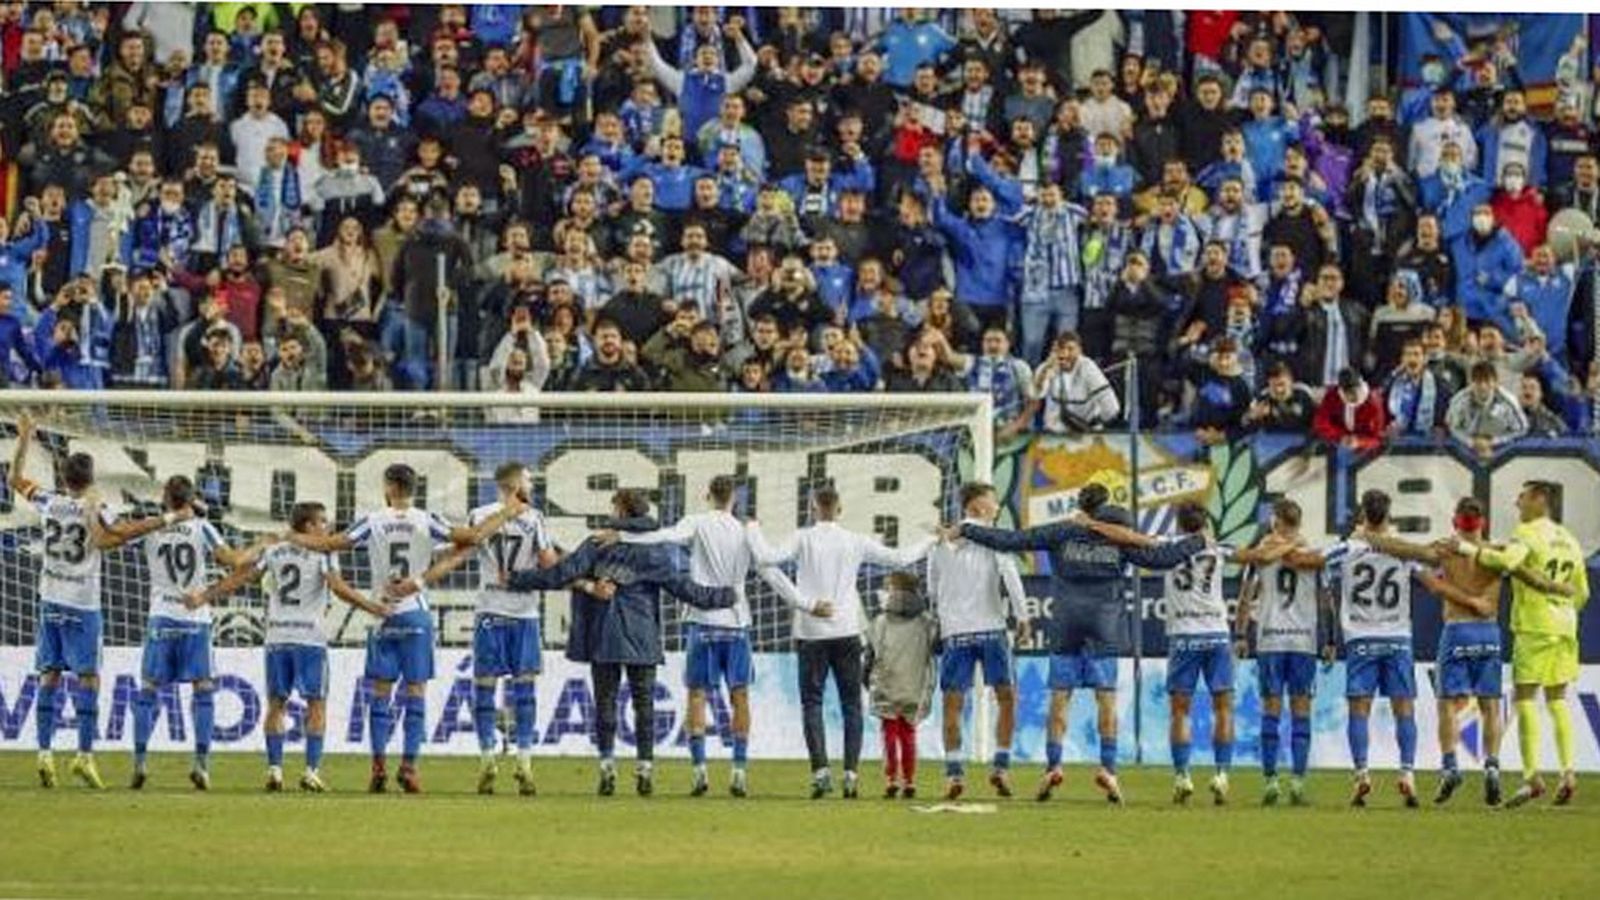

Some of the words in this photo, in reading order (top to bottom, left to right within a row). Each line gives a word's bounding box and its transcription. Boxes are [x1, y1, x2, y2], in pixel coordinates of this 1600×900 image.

[46, 518, 86, 564] 23
[390, 542, 410, 582] 5
[158, 541, 195, 588] 19
[279, 563, 301, 605] 2
[1278, 566, 1297, 609] 9
[1352, 562, 1400, 609] 26
[347, 654, 736, 746] MÁAGA
